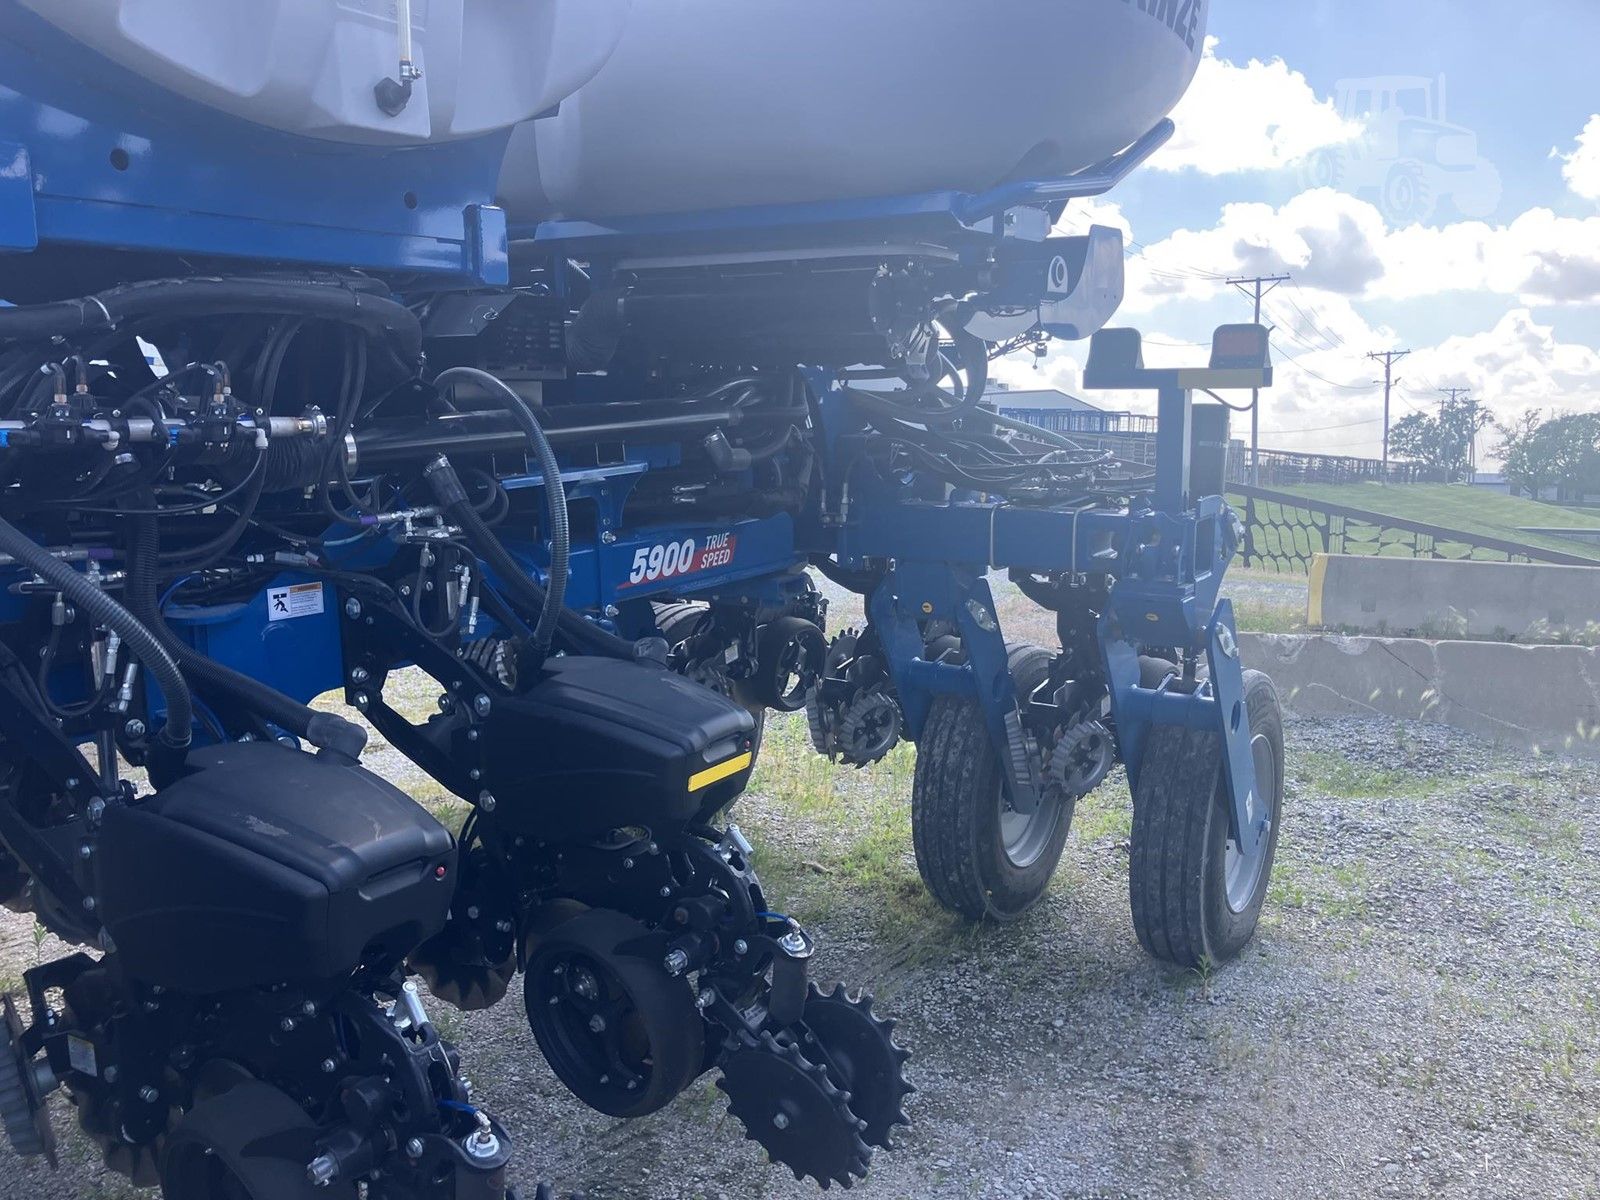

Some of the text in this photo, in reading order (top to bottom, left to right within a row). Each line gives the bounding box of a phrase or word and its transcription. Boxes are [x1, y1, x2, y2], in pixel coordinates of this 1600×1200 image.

[1121, 0, 1201, 53] NZE
[700, 548, 731, 569] SPEED
[705, 532, 731, 552] TRUE
[629, 538, 696, 584] 5900
